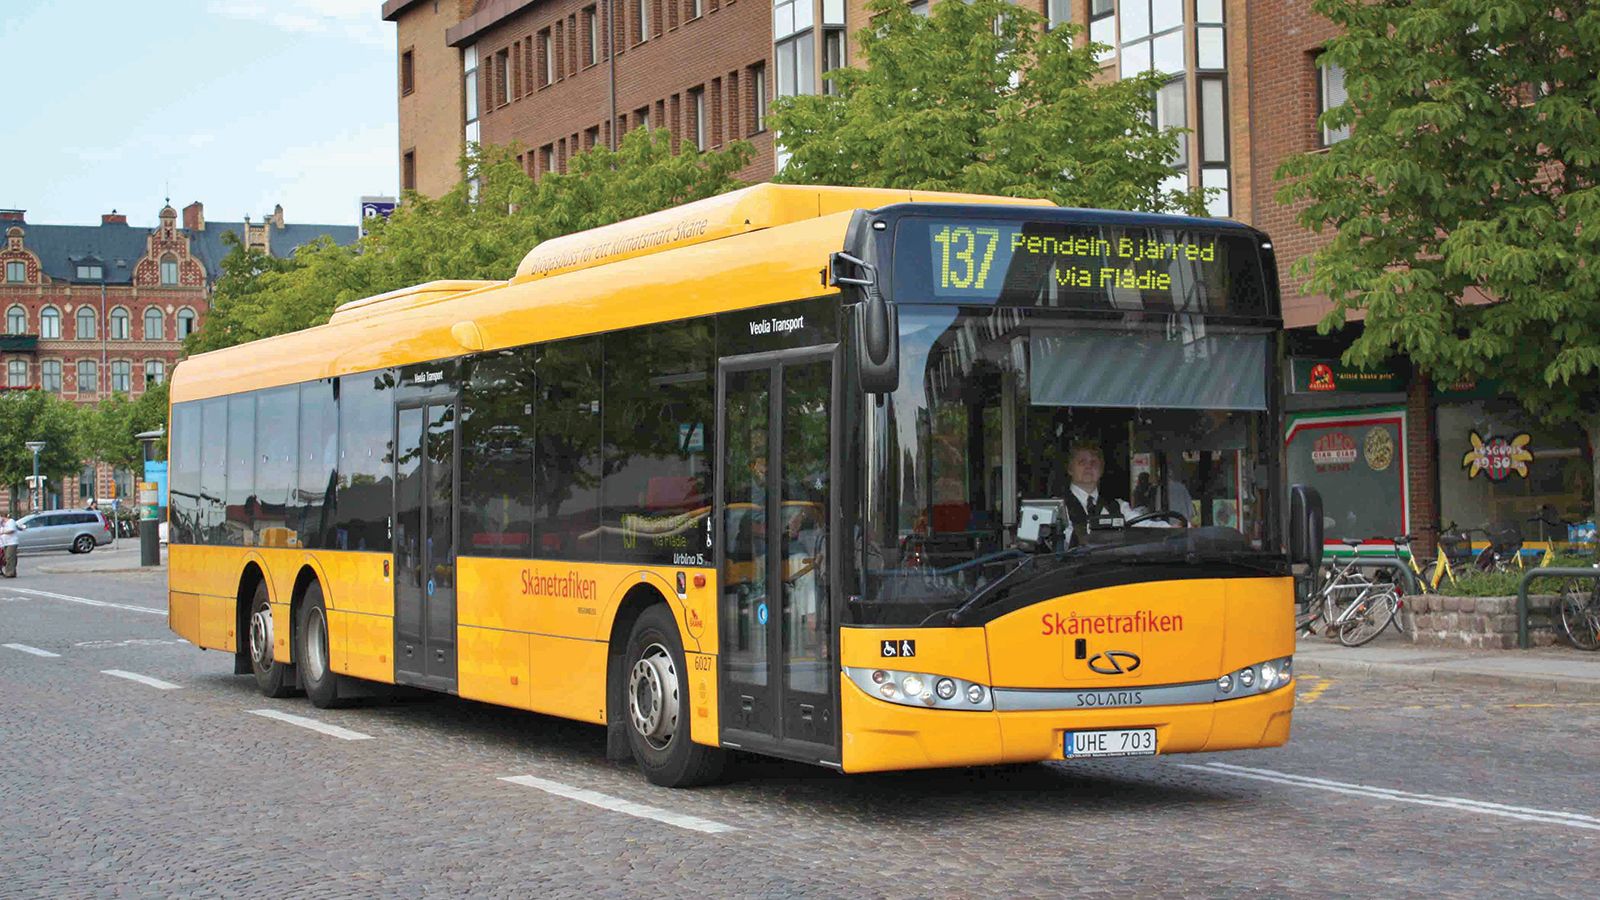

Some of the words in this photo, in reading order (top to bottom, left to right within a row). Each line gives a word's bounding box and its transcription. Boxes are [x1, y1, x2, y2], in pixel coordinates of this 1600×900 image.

[934, 226, 999, 289] 137
[1010, 233, 1111, 258] Pendeln
[1118, 237, 1214, 262] Bjärred
[1055, 266, 1091, 287] via
[750, 319, 771, 335] Veolia
[772, 315, 804, 333] Transport
[673, 552, 696, 565] Urbino
[696, 553, 704, 565] 15
[521, 567, 597, 600] Skånetrafiken
[1041, 610, 1184, 636] Skånetrafiken
[695, 655, 711, 670] 6027
[1076, 692, 1143, 707] SOLARIS
[1076, 733, 1108, 752] UHE
[1120, 732, 1152, 750] 703
